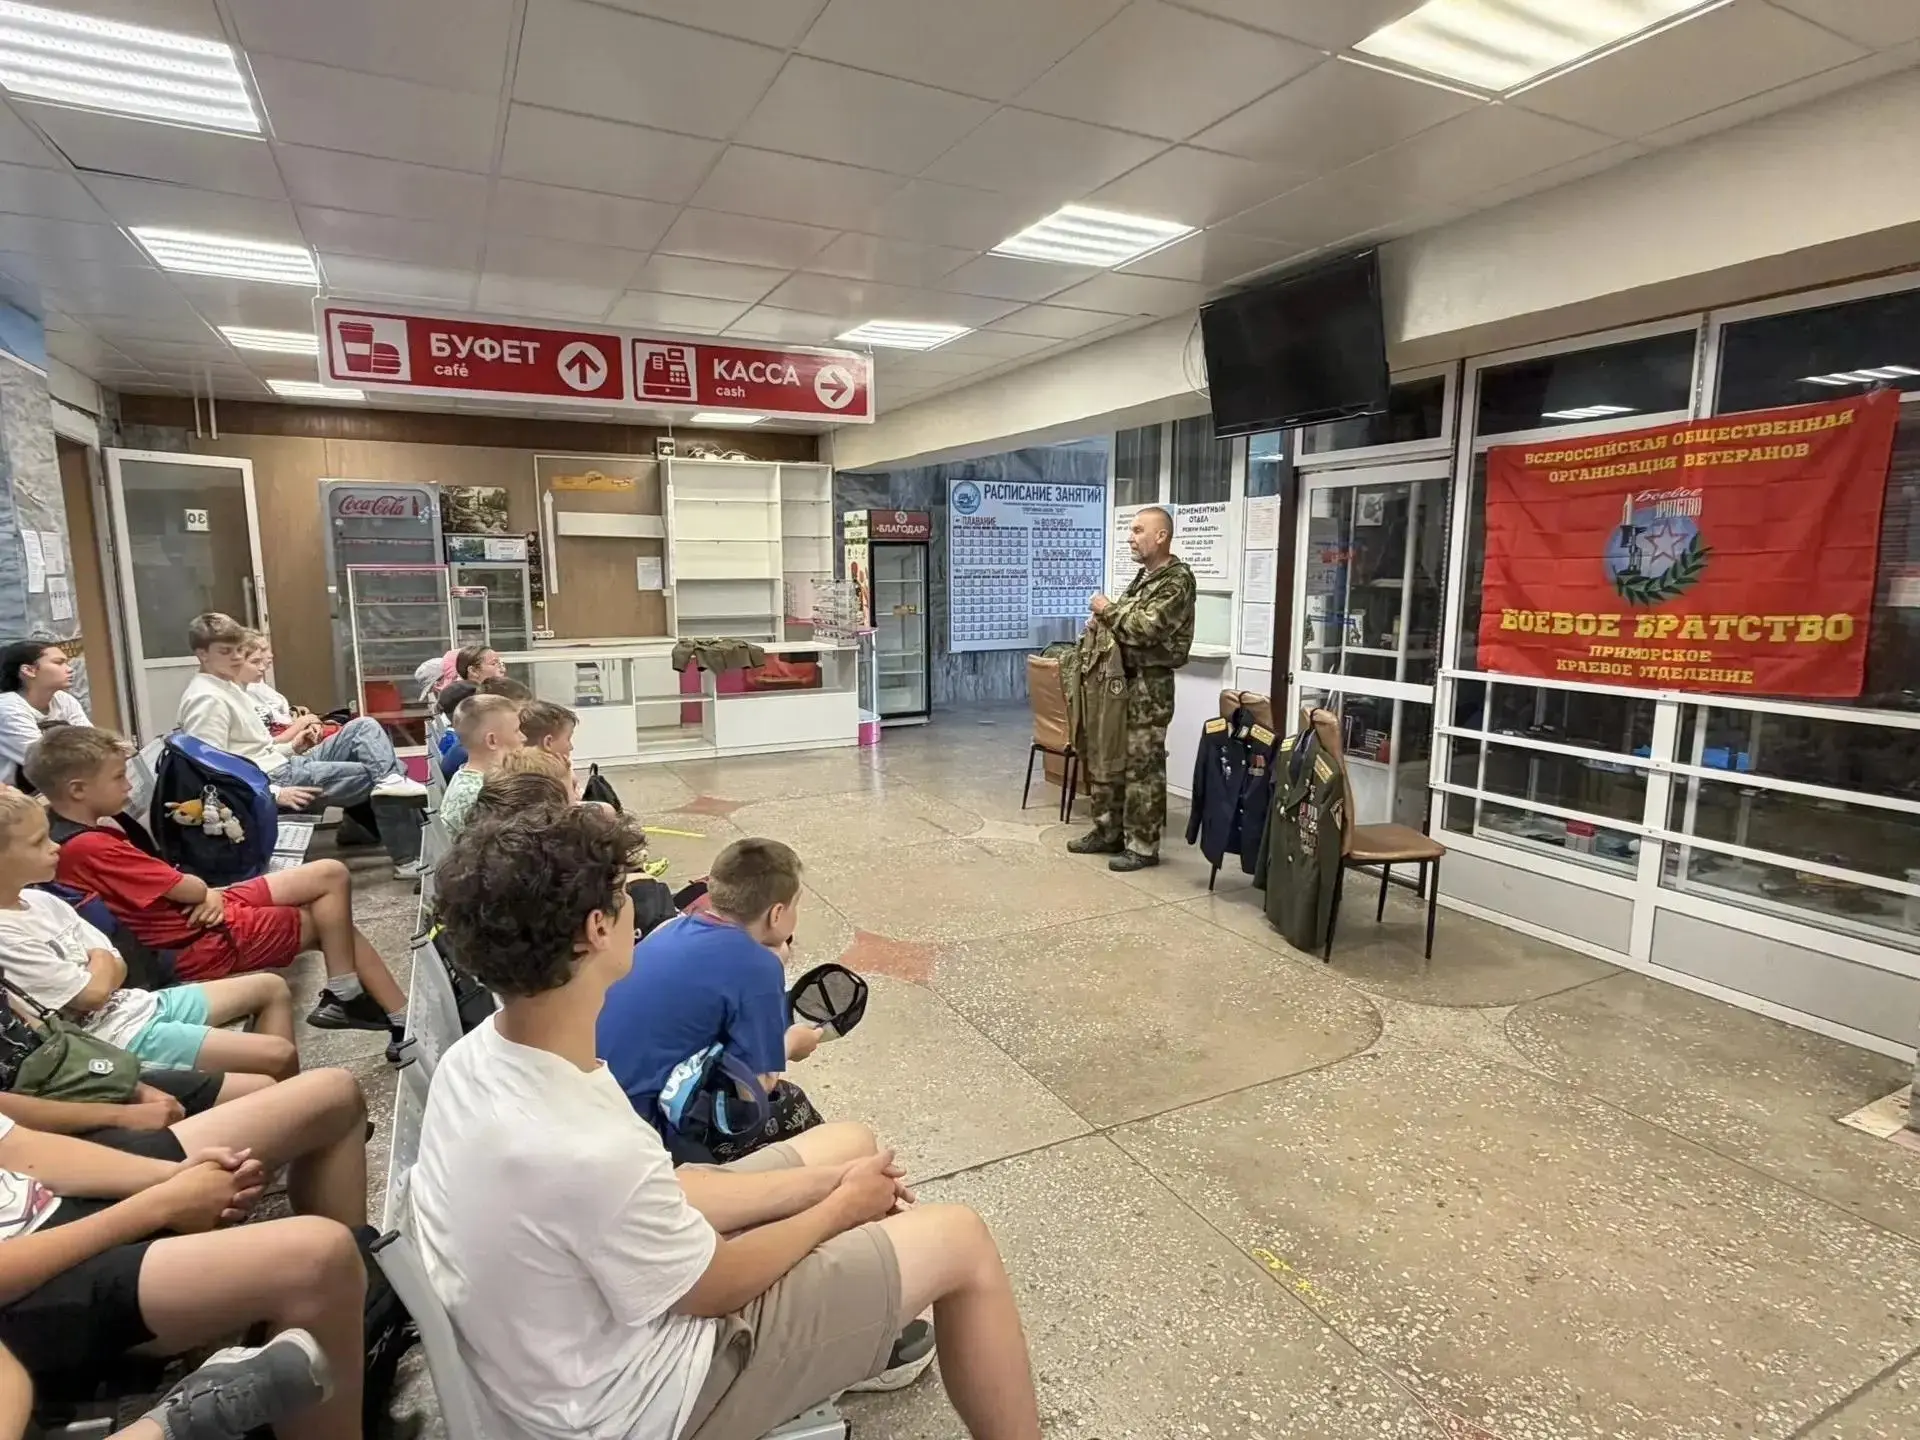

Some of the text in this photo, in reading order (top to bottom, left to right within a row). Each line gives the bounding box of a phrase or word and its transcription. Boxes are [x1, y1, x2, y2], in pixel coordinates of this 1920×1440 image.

[430, 332, 540, 365] БУФЕТ
[434, 362, 469, 377] café
[713, 358, 801, 386] КАССА
[715, 385, 746, 398] cash
[1524, 409, 1855, 465] ВСЕРОССИЙСКАЯ ОБЩЕСТВЕННАЯ
[1549, 442, 1810, 483] ОРГАНИЗАЦИЯ ВЕТЕРАНОВ
[983, 483, 1101, 503] РАСПИСАНИЕ ЗАНЯТИЙ
[339, 495, 408, 516] Coca-Cola
[1177, 504, 1226, 515] БОНЕМЕНТНЫЙ
[1500, 608, 1854, 643] БОЕВОЕ БРАТСТВО
[1588, 644, 1712, 663] ПРИМОРСКОЕ
[1556, 658, 1633, 676] КРАЕВОЕ
